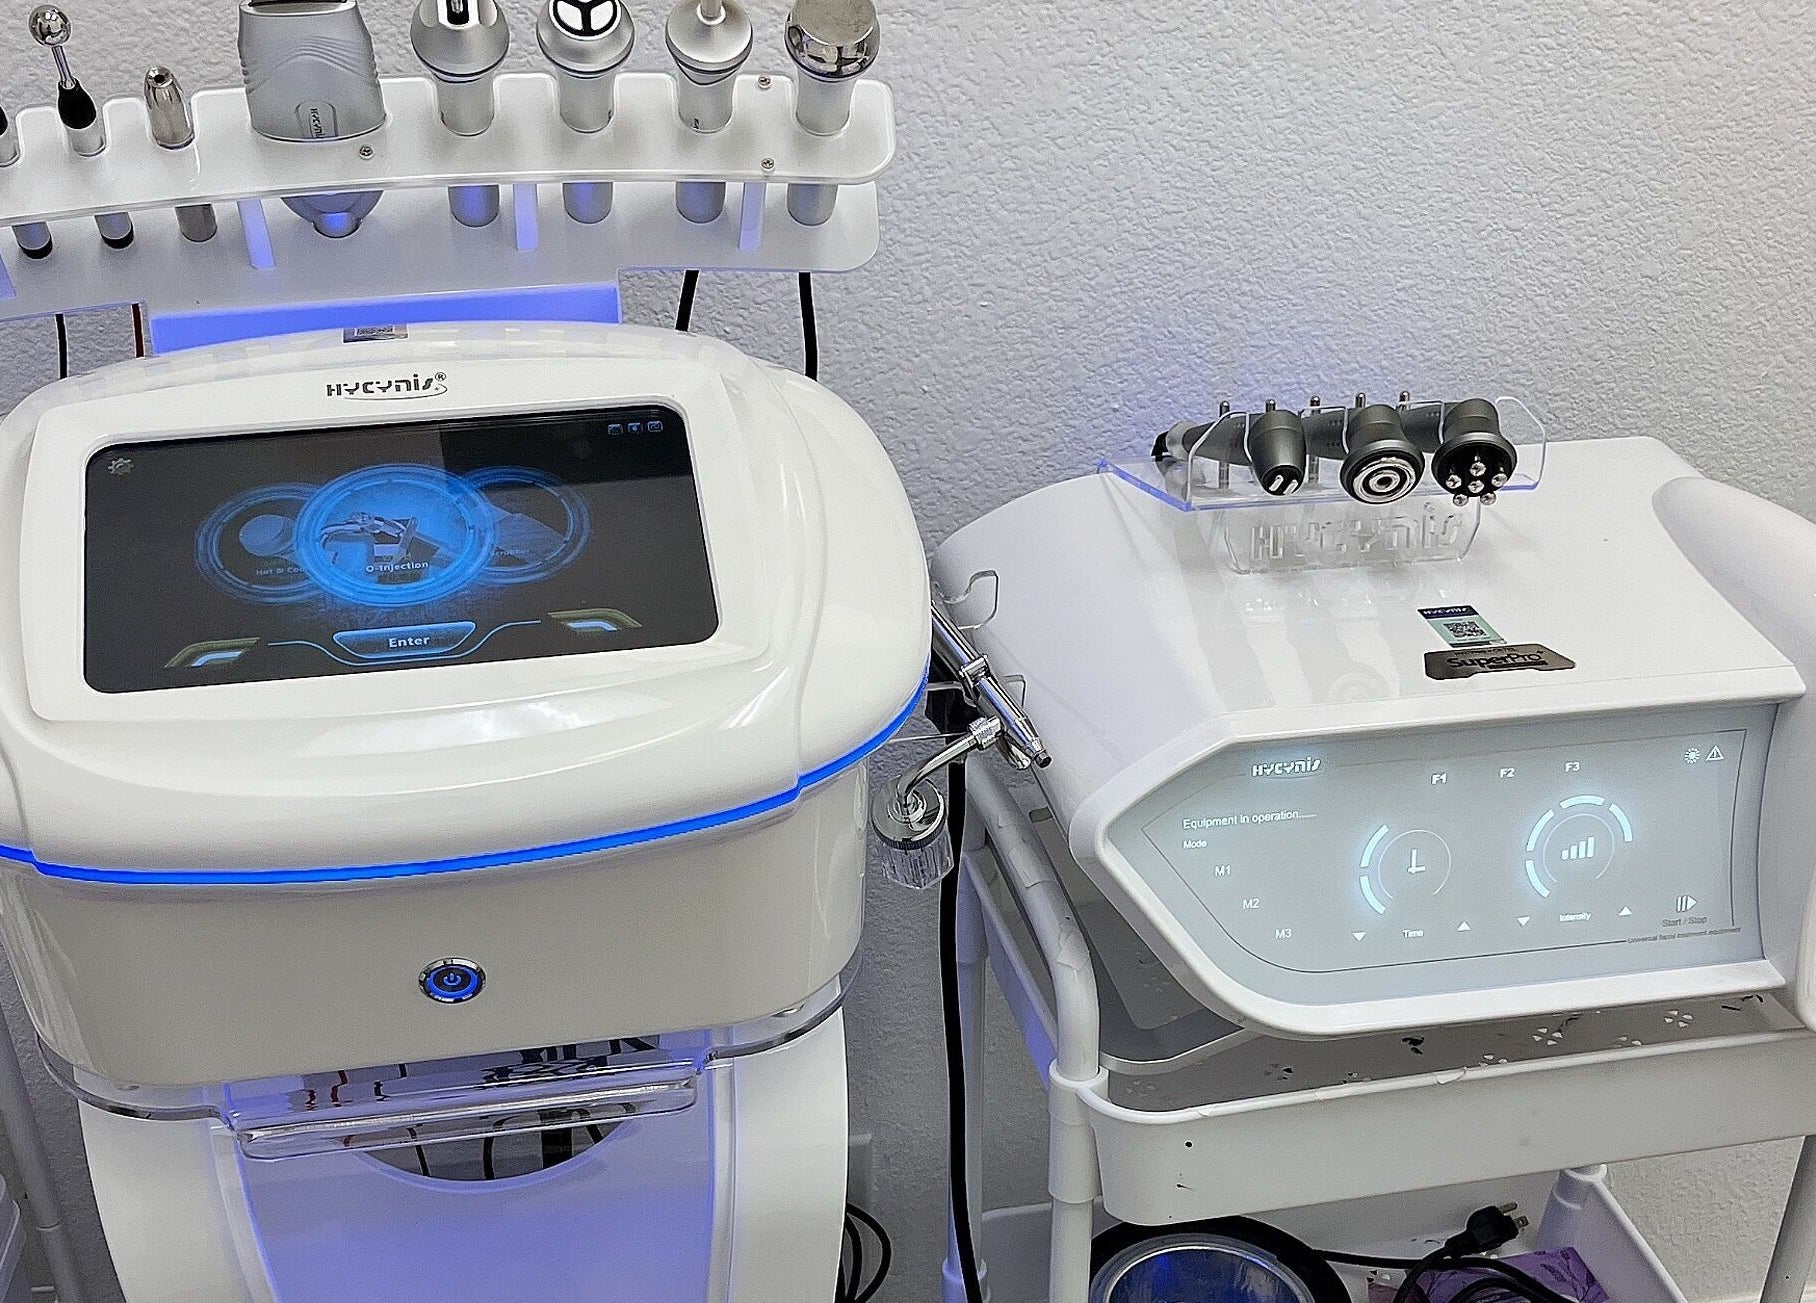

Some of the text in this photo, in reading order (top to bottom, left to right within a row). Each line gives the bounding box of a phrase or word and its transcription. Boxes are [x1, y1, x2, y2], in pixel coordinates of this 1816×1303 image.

[388, 636, 431, 648] Enter
[1499, 767, 1516, 779] F2
[1565, 761, 1581, 773] F3
[1431, 773, 1448, 785] F1
[1182, 815, 1238, 830] Equipment
[1240, 814, 1250, 824] in
[1183, 839, 1208, 850] Mode
[1214, 865, 1232, 877] M1
[1243, 898, 1260, 909] M2
[1559, 911, 1592, 923] Intensity
[1275, 928, 1293, 939] M3
[1403, 928, 1424, 939] Time
